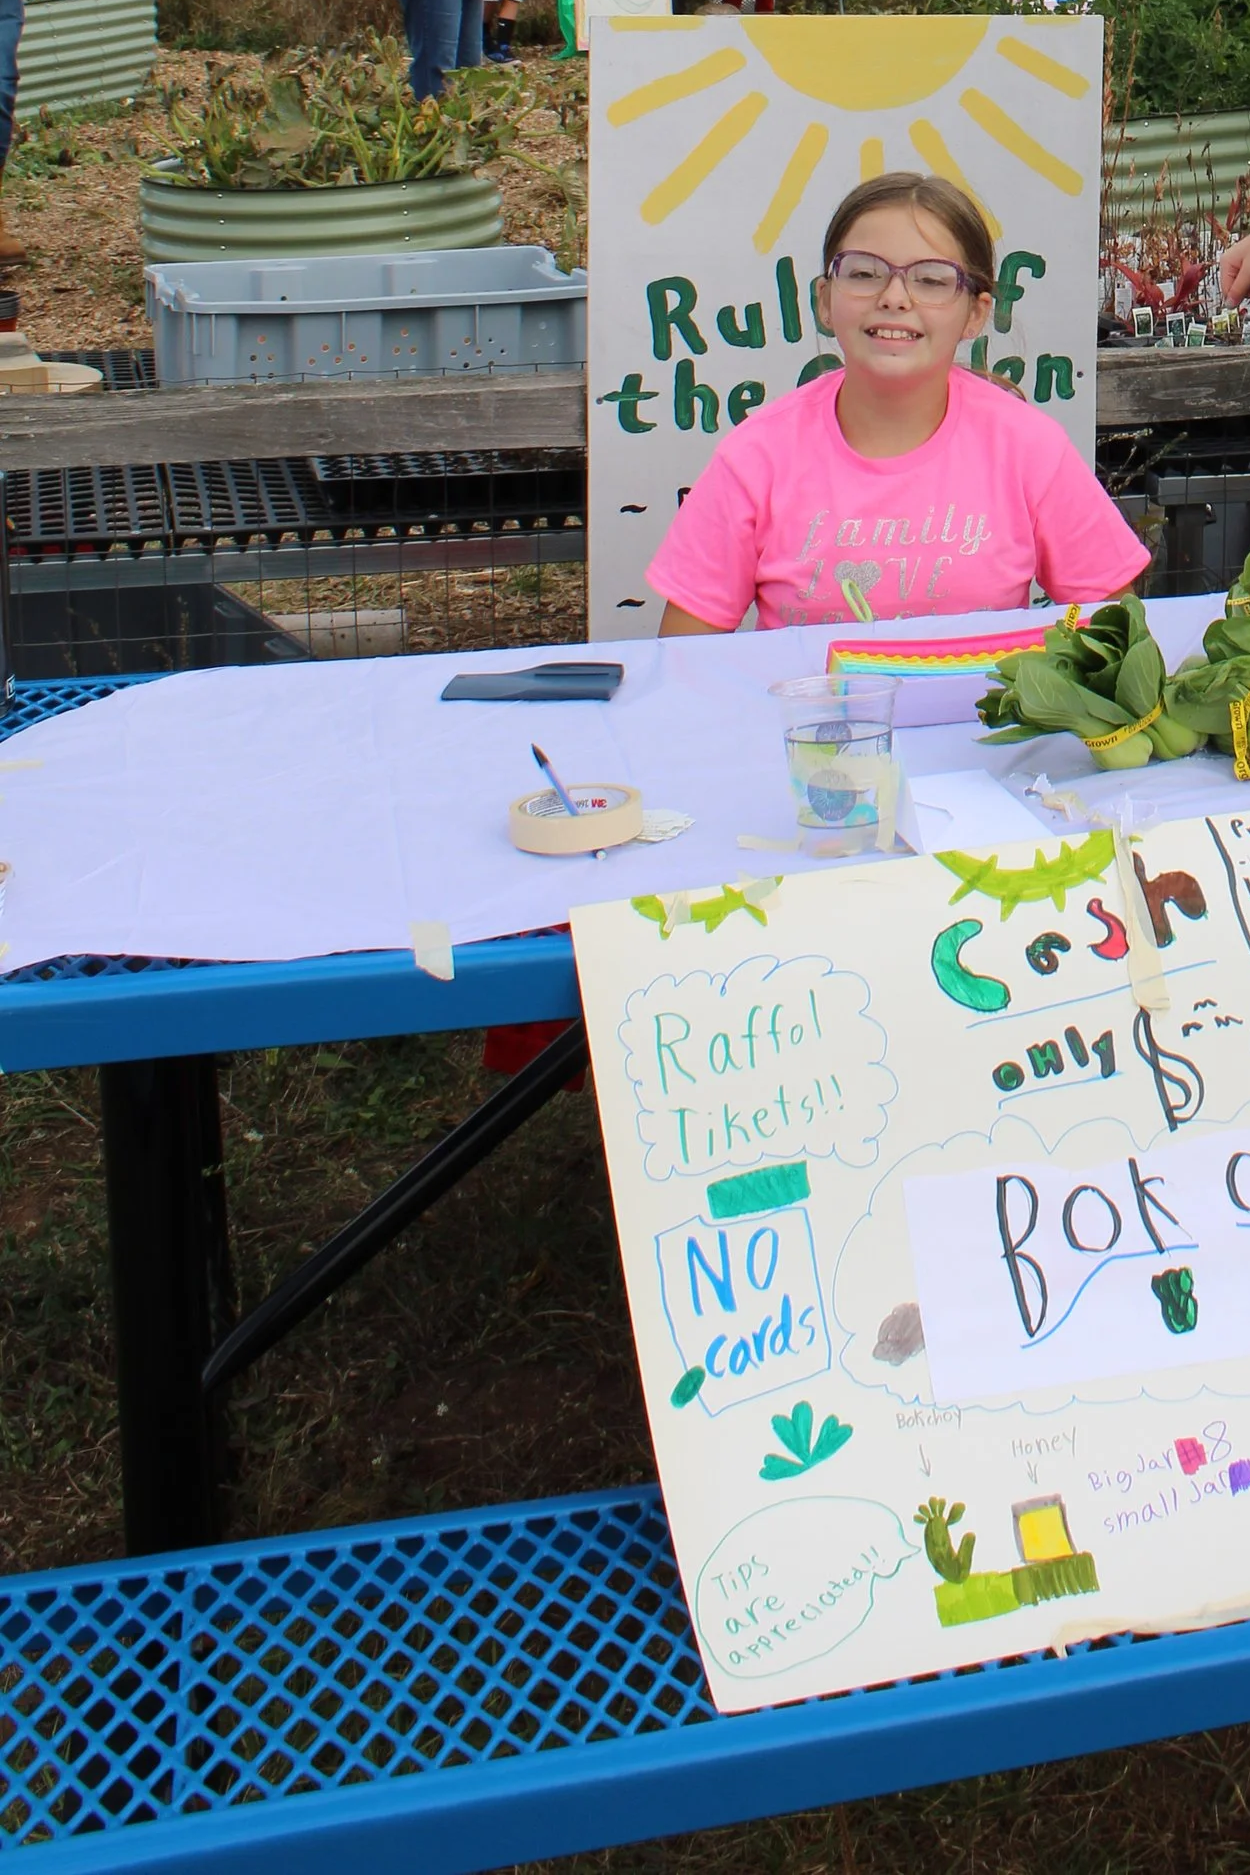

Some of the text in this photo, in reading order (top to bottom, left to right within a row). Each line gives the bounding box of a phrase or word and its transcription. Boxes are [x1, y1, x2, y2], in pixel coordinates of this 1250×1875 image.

[646, 255, 836, 361] Rul
[796, 504, 993, 562] family
[590, 798, 607, 808] 3M
[654, 989, 822, 1095] Raffol
[991, 1025, 1116, 1092] only
[668, 1074, 845, 1164] Tikets!!
[686, 1227, 780, 1317] NO
[996, 1157, 1182, 1338] BOK
[704, 1293, 816, 1378] cards
[1010, 1425, 1077, 1459] Honey
[1087, 1469, 1133, 1494] Big
[1103, 1486, 1179, 1534] small
[710, 1554, 770, 1601] Tips
[724, 1594, 786, 1635] are
